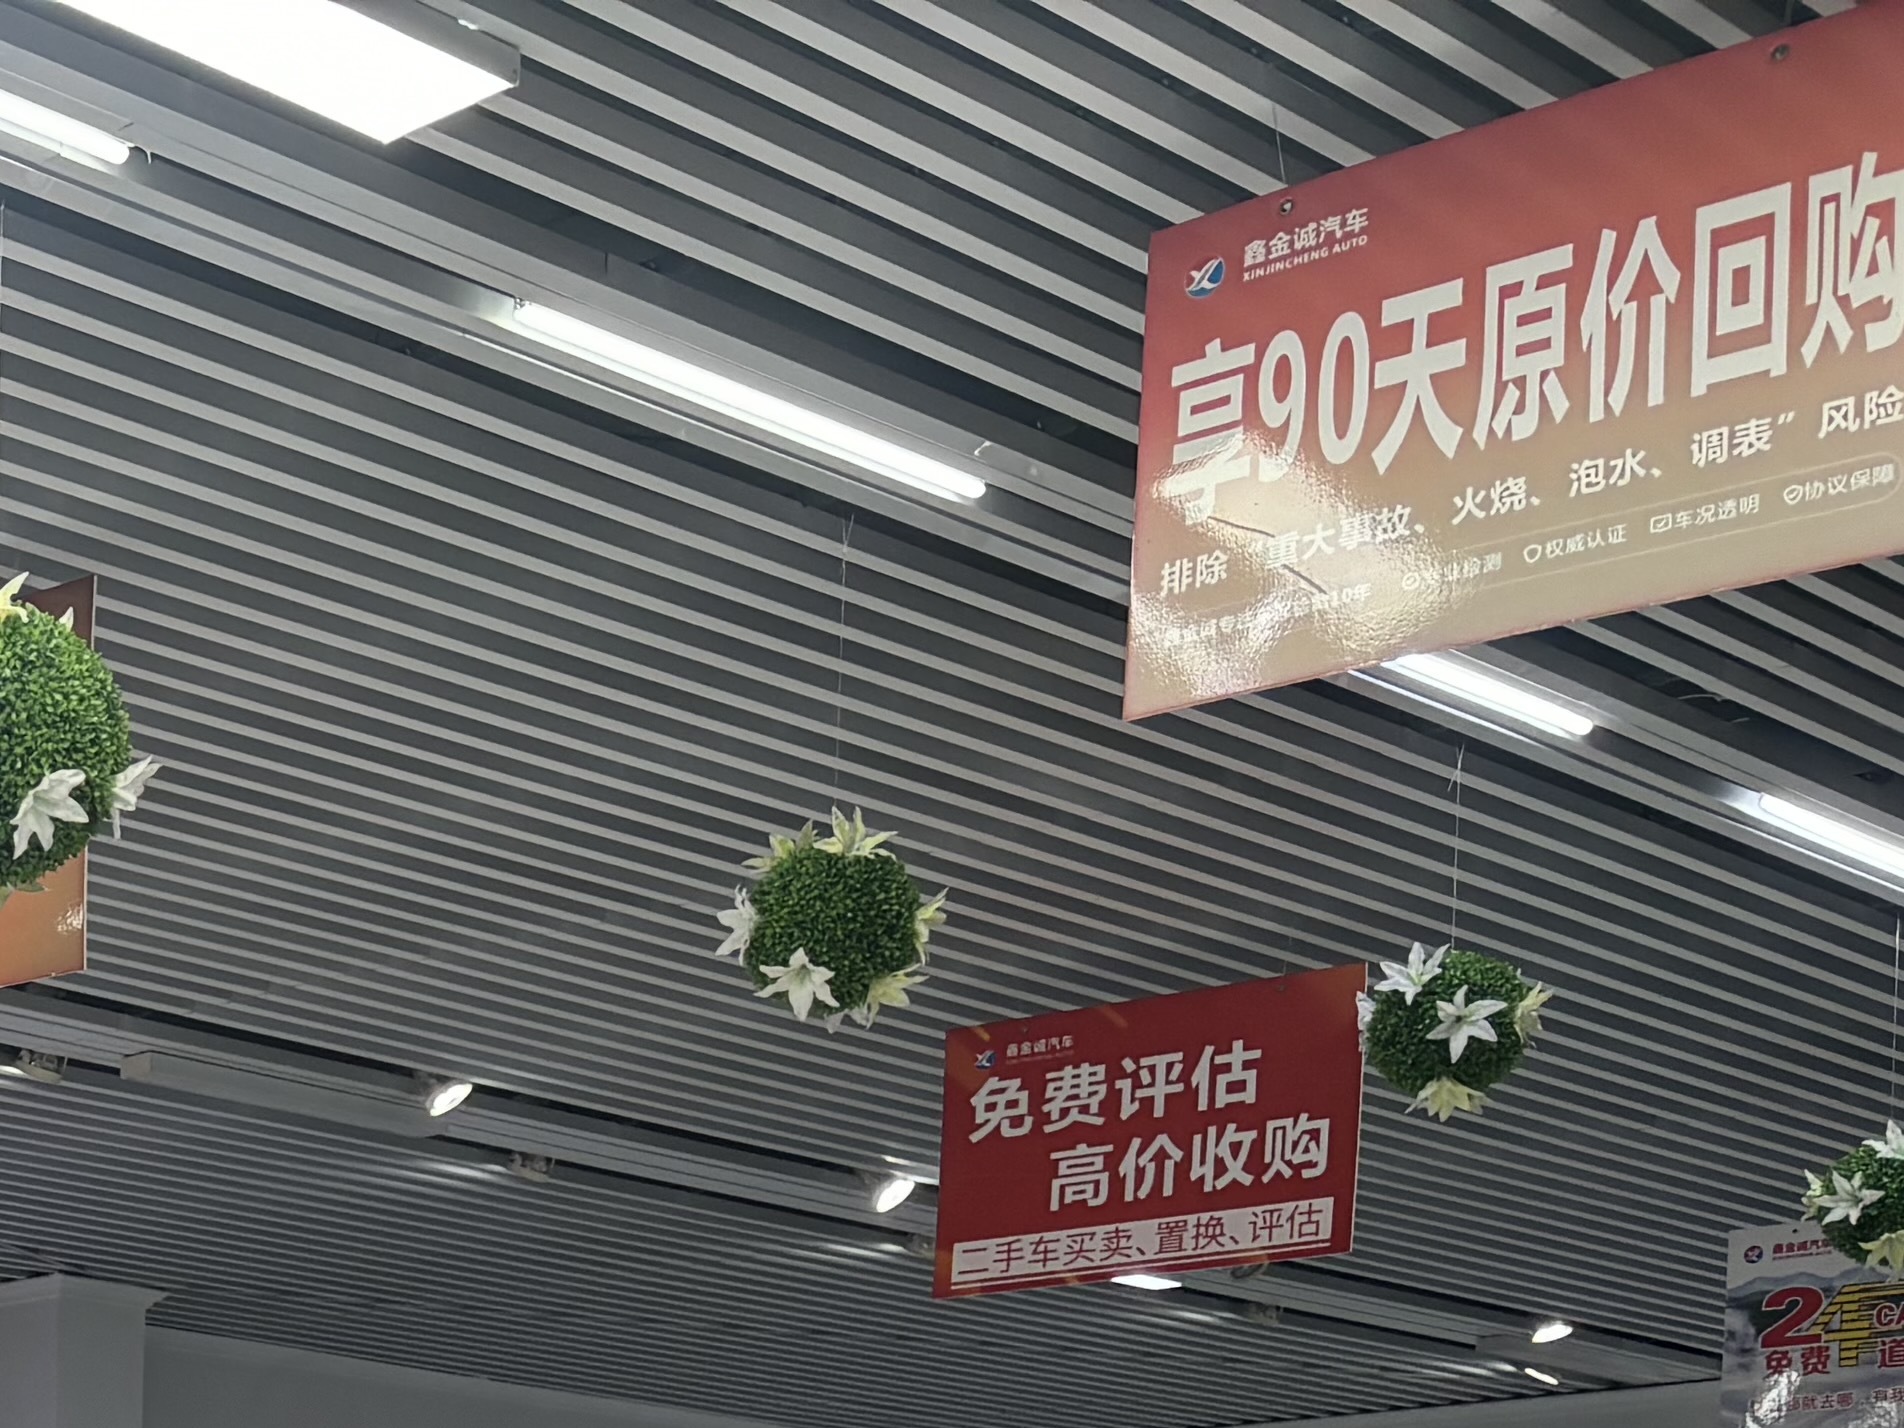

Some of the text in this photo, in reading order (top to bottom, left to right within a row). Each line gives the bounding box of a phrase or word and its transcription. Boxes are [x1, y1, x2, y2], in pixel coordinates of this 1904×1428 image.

[1242, 234, 1368, 282] XINJINCHENG AUTO
[1244, 207, 1369, 267] 鑫金诚汽车
[1168, 151, 1904, 526] 享90天原价回购
[1674, 492, 1761, 530] 车况透明
[1160, 550, 1228, 597] 排除
[968, 1039, 1263, 1143] 免费评估
[1049, 1112, 1331, 1212] 高价收购
[957, 1201, 1325, 1278] 二手车买卖、置换、评估
